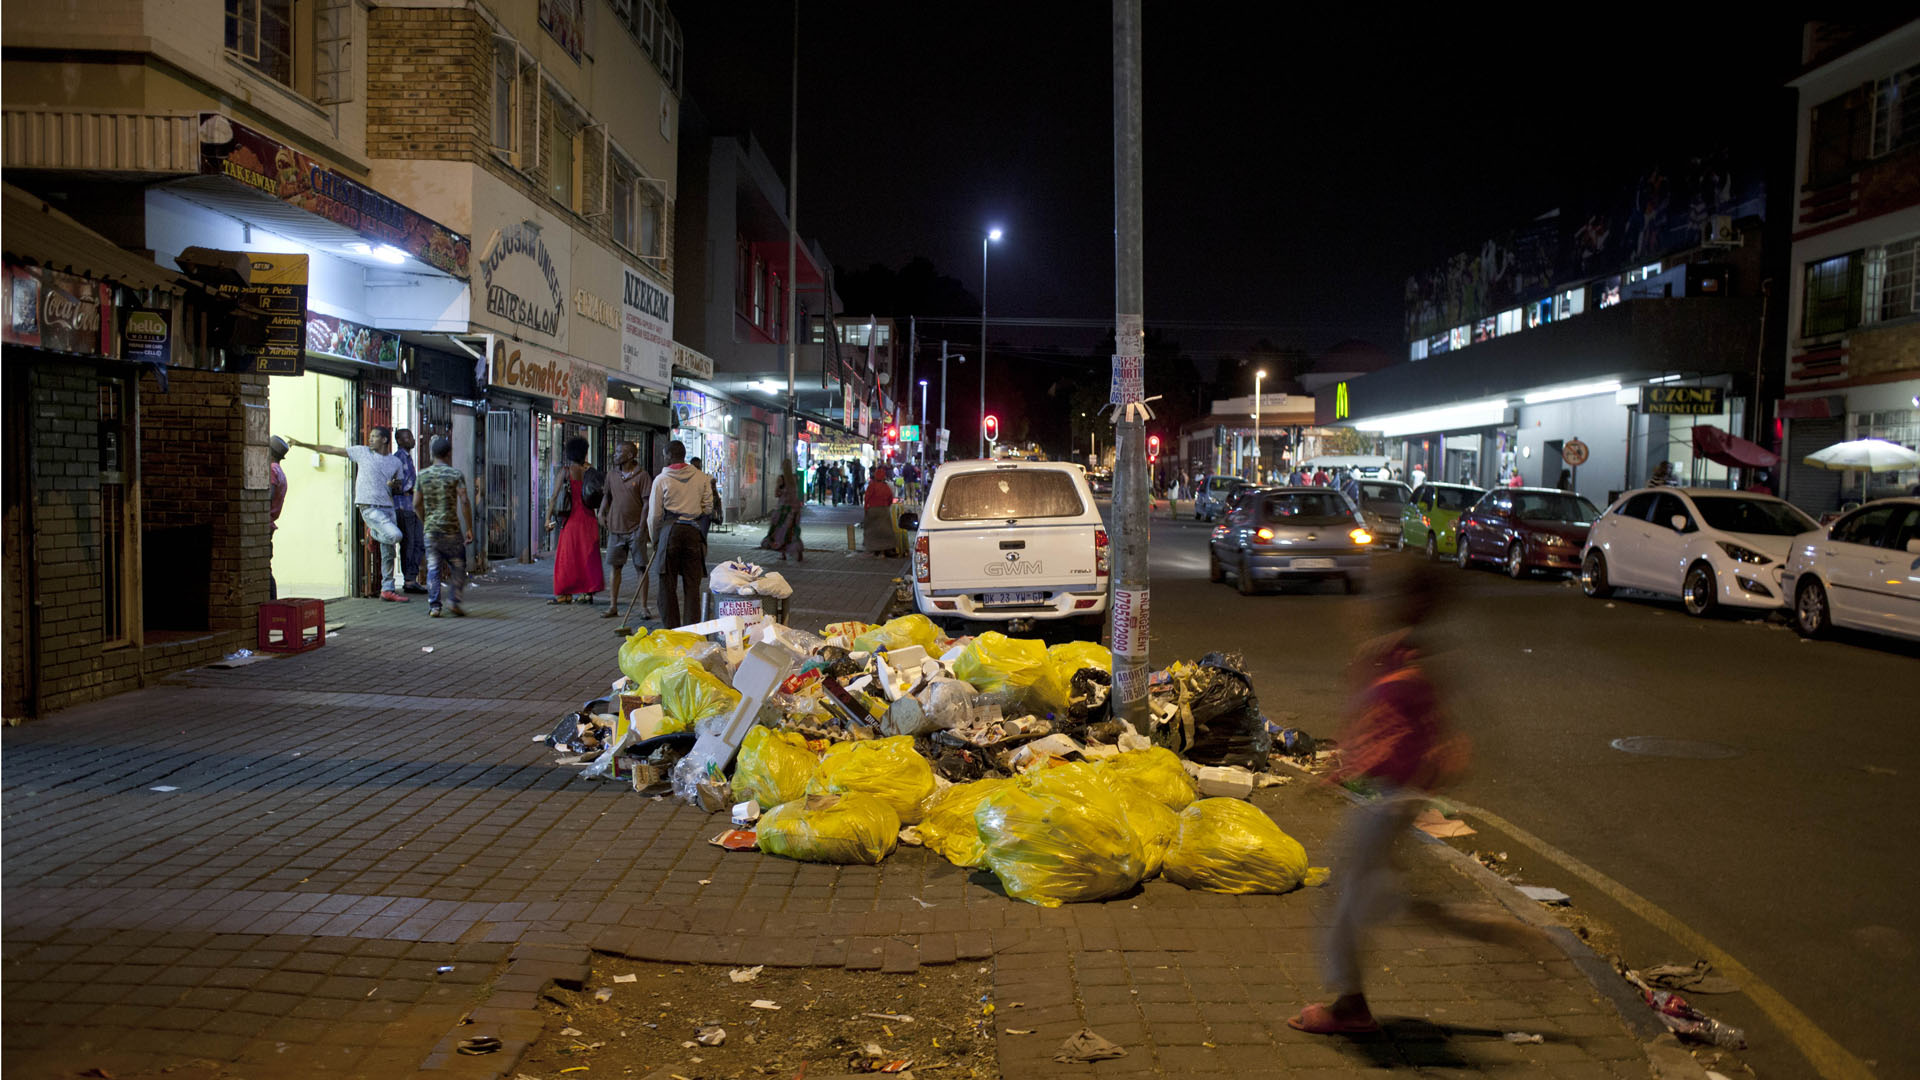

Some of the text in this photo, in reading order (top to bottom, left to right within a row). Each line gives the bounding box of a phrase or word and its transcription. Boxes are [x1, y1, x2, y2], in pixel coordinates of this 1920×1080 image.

[222, 159, 278, 195] TAKEAWAY
[537, 239, 566, 317] UNISEX
[218, 284, 239, 293] MTN
[272, 286, 293, 295] Pack
[262, 298, 271, 308] R
[623, 270, 670, 324] NEEKEM
[490, 288, 519, 320] HAIR
[517, 299, 561, 335] SALON
[129, 319, 163, 333] hello
[271, 316, 301, 326] Airtime
[259, 358, 268, 369] R
[506, 349, 569, 398] Cosmetics
[1110, 391, 1143, 403] 0631254
[1649, 388, 1716, 402] OZONE
[1649, 404, 1690, 414] INTERNET
[983, 560, 1043, 577] GWM
[984, 593, 994, 604] DK
[1000, 593, 1010, 603] 23
[1032, 592, 1043, 602] GP
[720, 607, 761, 616] ENLARGEMENT
[1114, 591, 1132, 652] 0795332999
[1137, 592, 1149, 652] ENLARGEMENT
